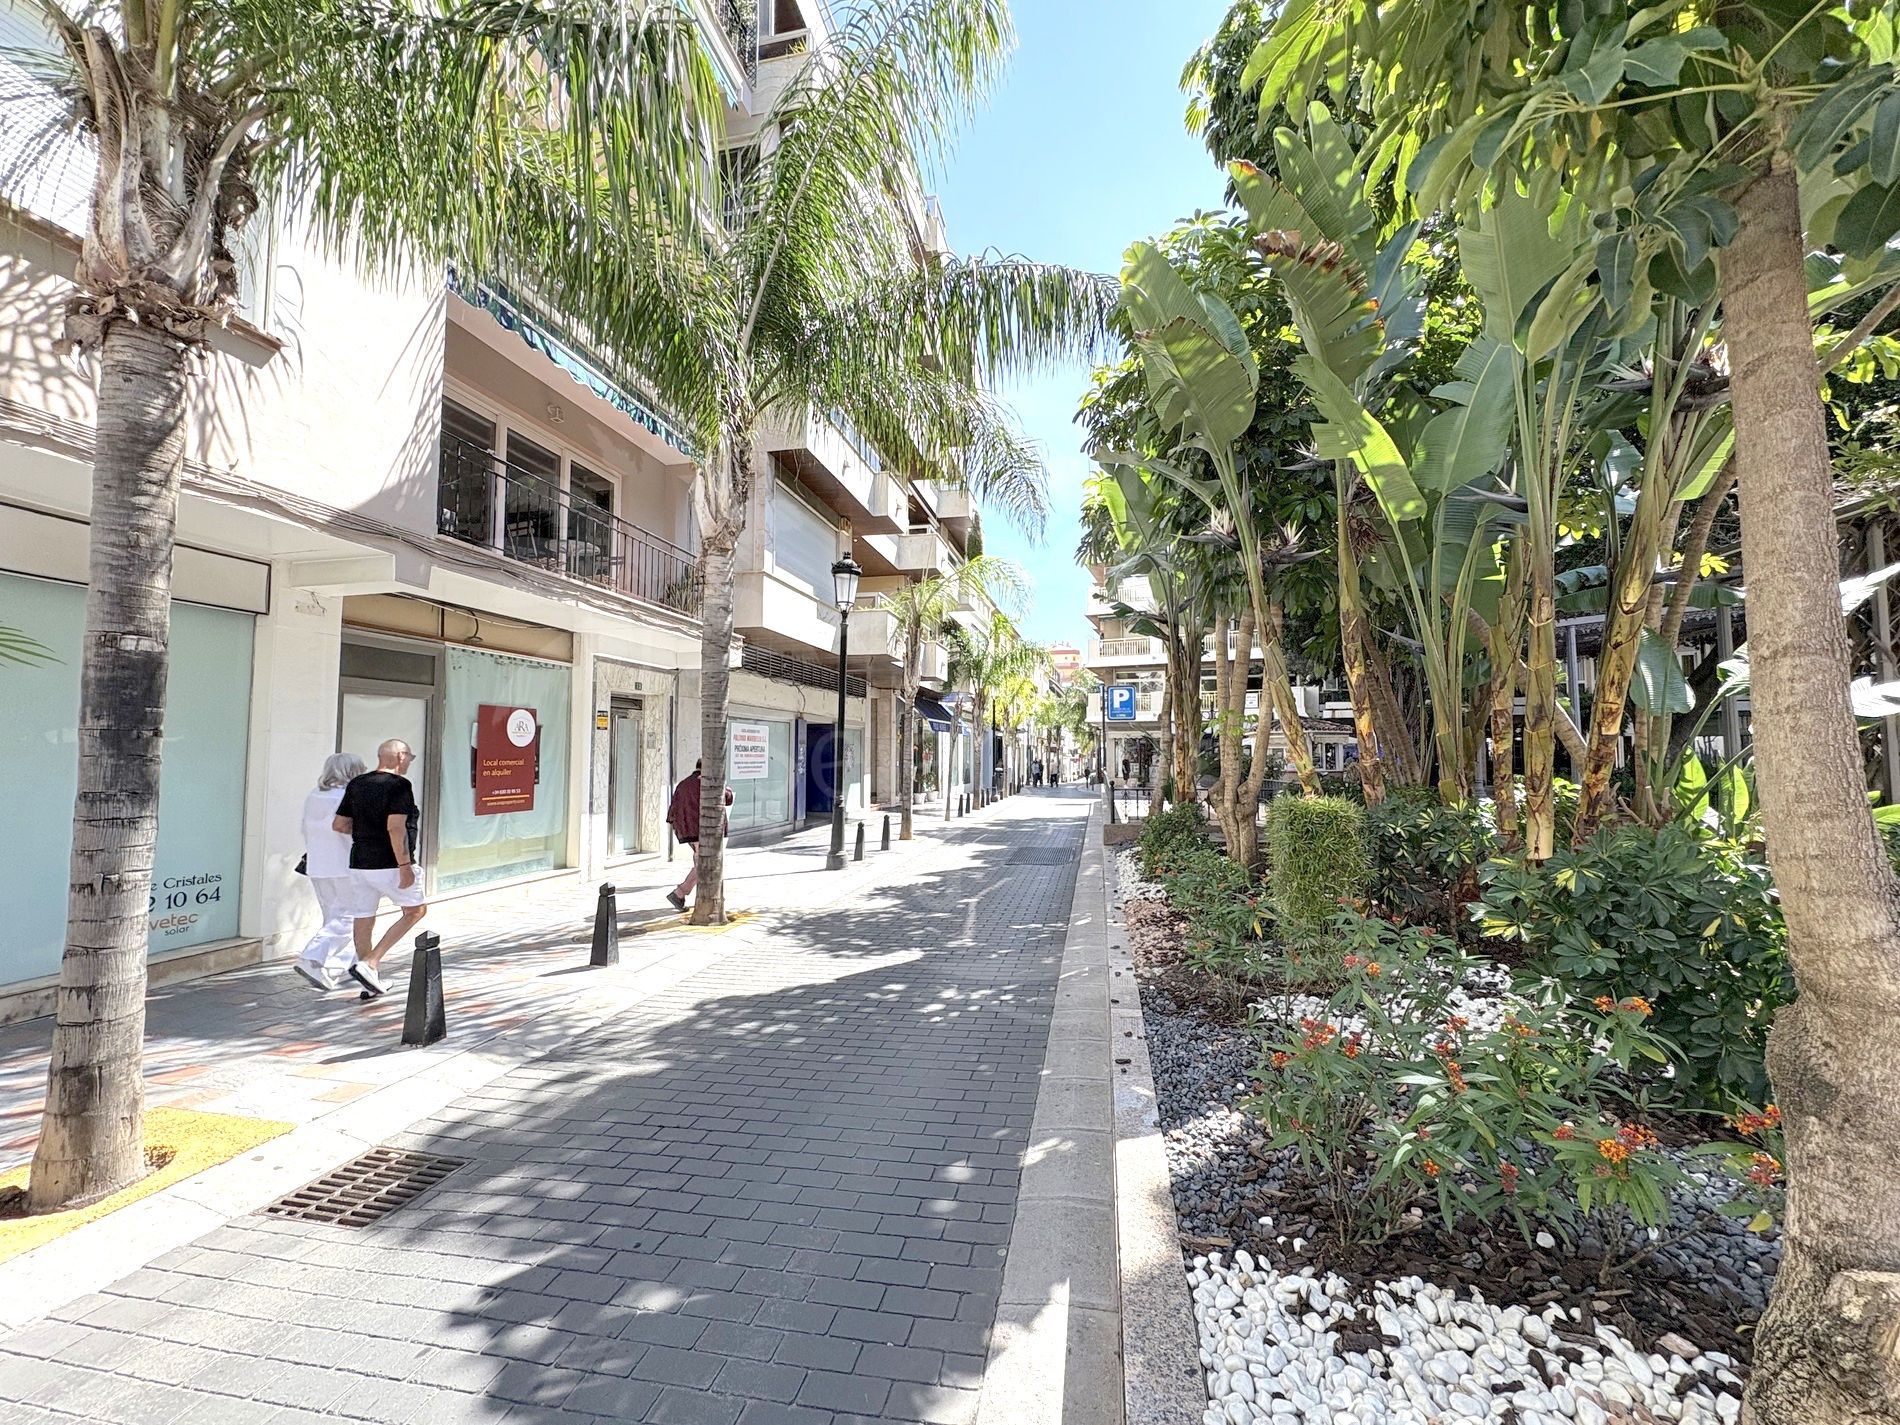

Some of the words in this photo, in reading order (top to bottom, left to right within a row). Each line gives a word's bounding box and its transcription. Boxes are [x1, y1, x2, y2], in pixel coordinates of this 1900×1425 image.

[1113, 689, 1130, 708] P
[483, 759, 498, 767] Local
[499, 758, 525, 767] comercial
[491, 769, 512, 777] alquiler
[163, 873, 222, 889] Cristales
[165, 891, 187, 910] 10
[196, 886, 221, 904] 64
[164, 925, 190, 936] solar
